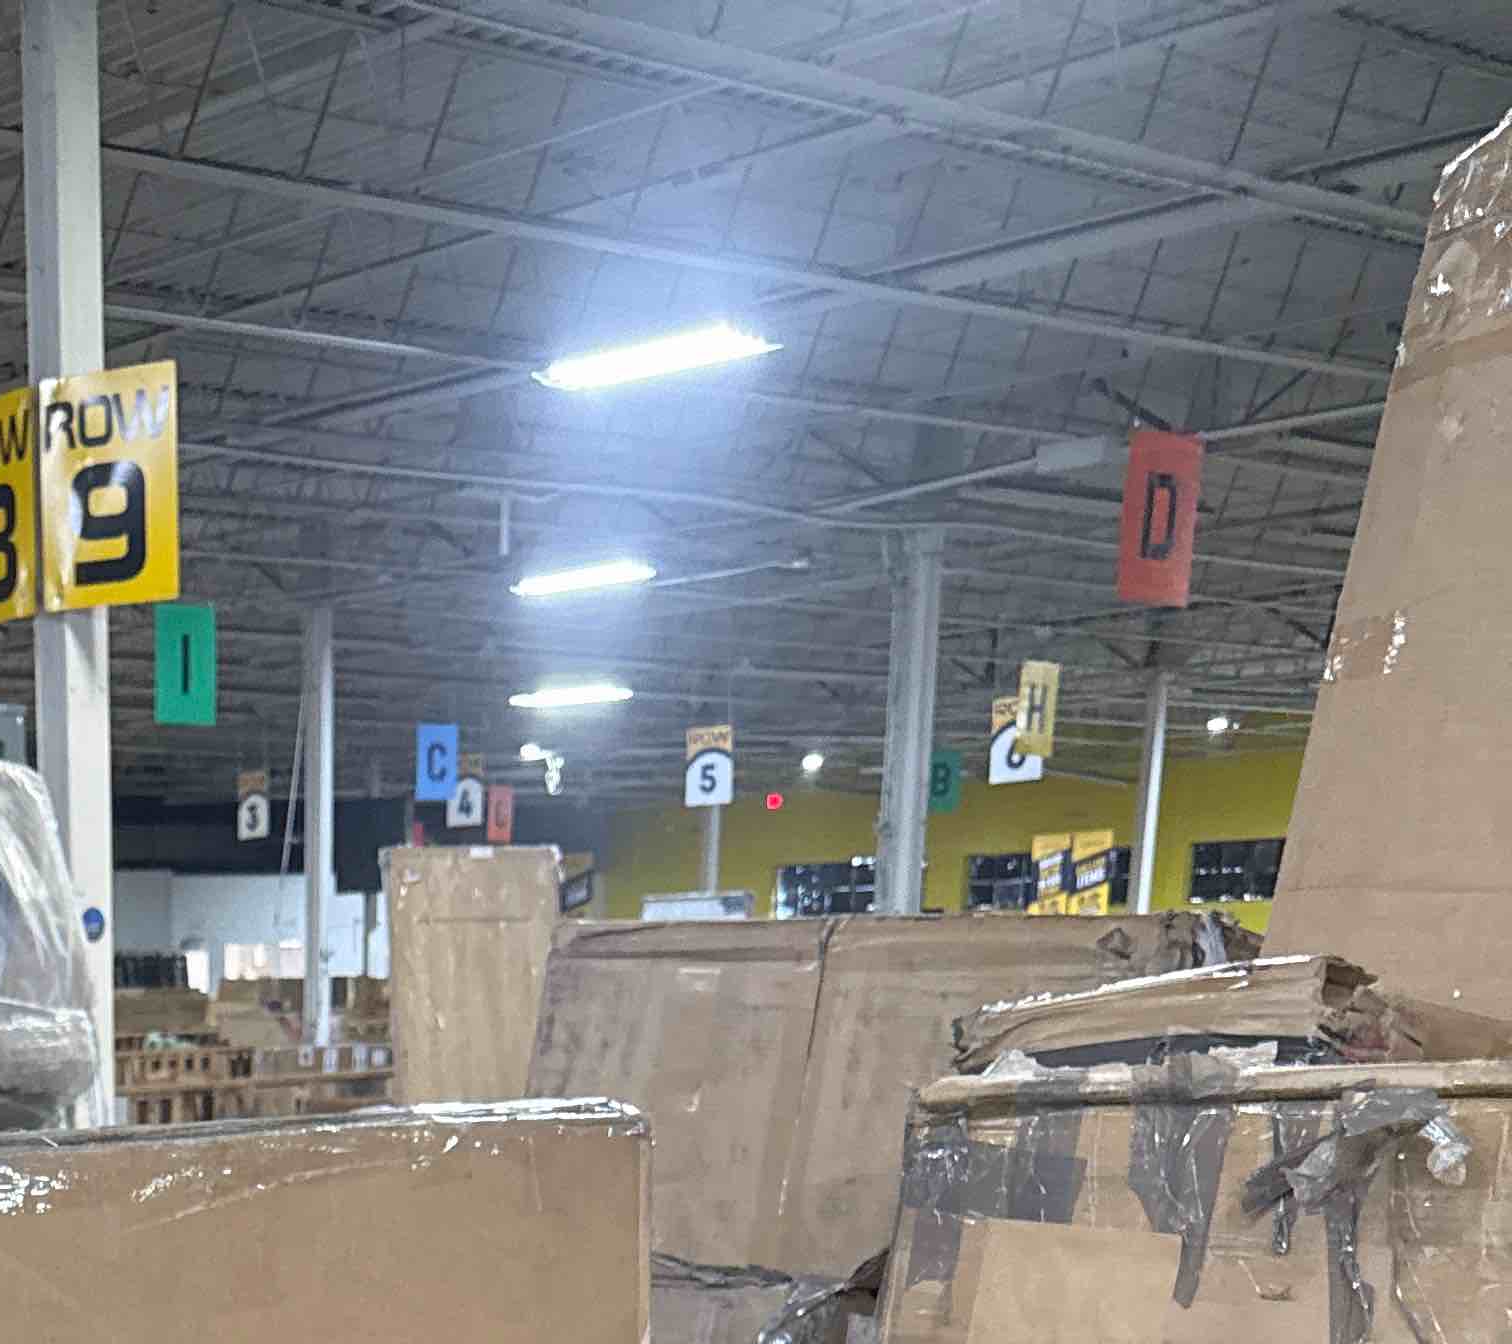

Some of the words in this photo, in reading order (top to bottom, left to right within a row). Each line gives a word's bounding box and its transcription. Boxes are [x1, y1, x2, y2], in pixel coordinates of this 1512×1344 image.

[45, 385, 170, 453] ROW
[72, 461, 146, 587] 9
[1141, 472, 1177, 559] D
[1028, 682, 1048, 735] H
[427, 743, 446, 782] C
[699, 763, 717, 795] 5
[458, 789, 473, 818] 4
